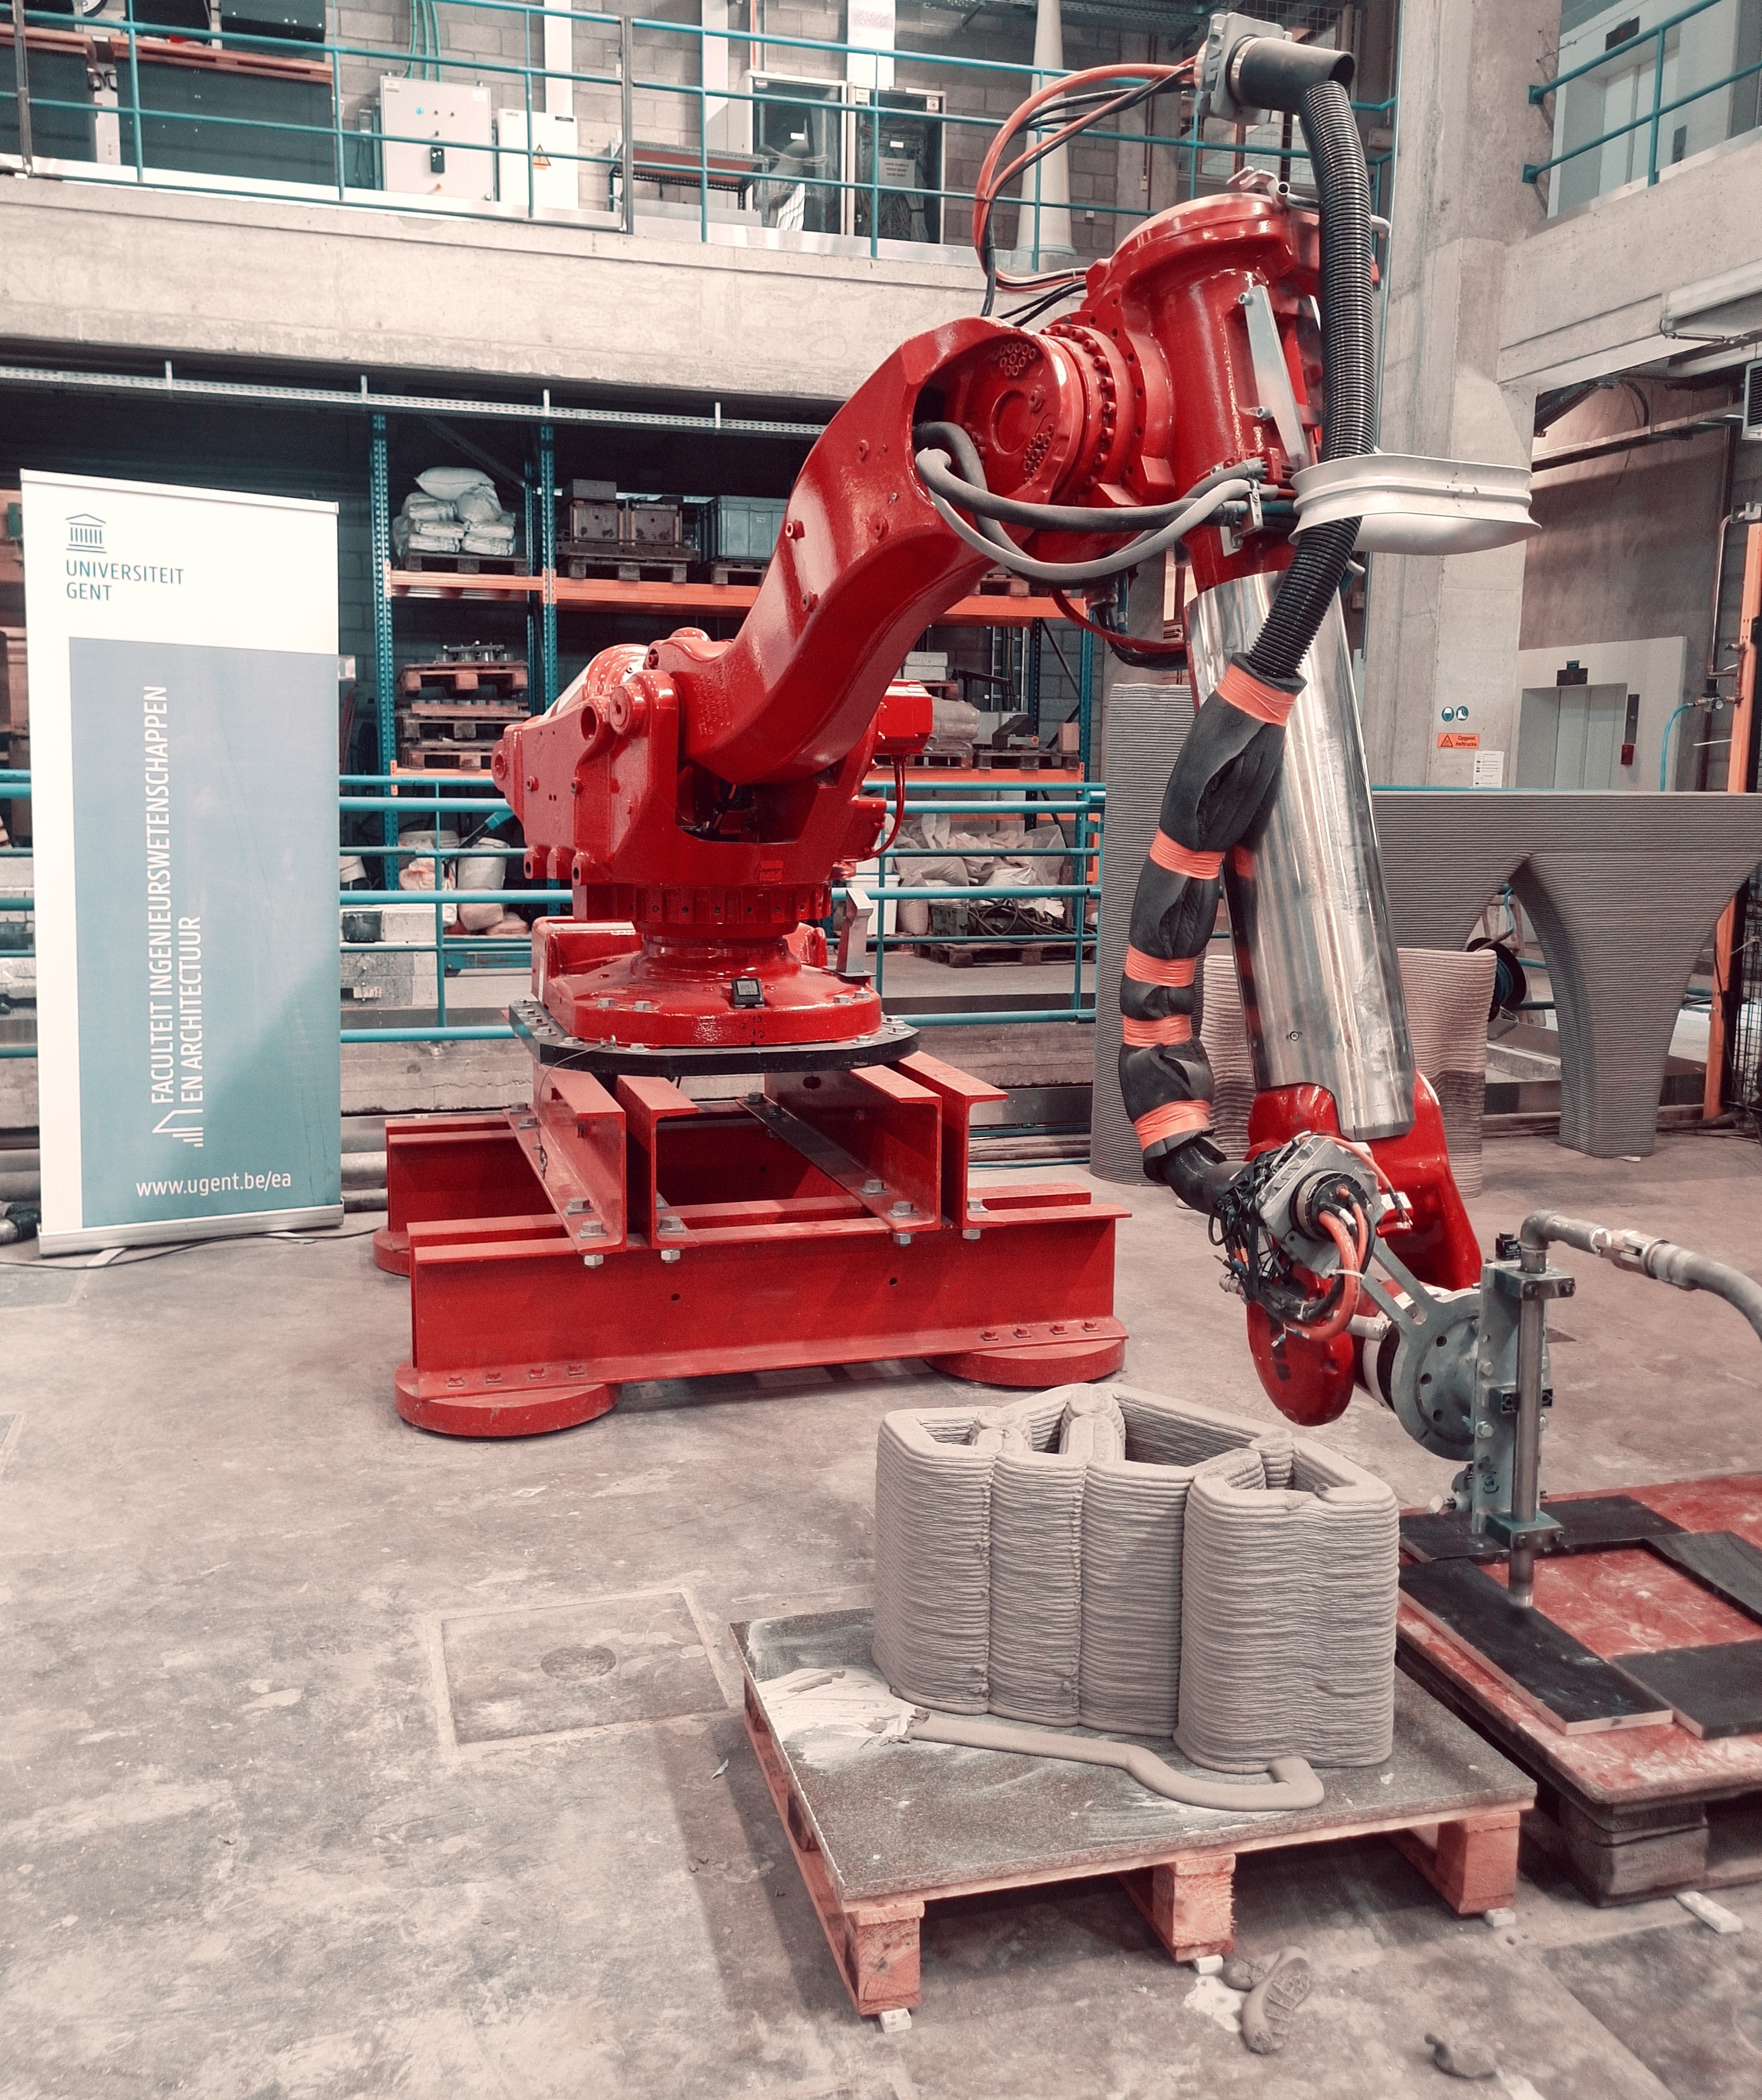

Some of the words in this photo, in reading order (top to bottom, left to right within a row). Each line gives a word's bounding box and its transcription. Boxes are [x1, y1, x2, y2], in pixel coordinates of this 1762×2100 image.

[66, 559, 184, 585] UNIVERSITEIT
[67, 582, 112, 601] GENT
[143, 685, 173, 996] INGENIEURSWETENSCHAPPEN
[178, 916, 203, 1070] ARCHITECTUUR
[149, 1001, 174, 1104] FACULTEIT
[180, 1075, 203, 1103] EN
[136, 1170, 292, 1197] www.ugent.be/ea
